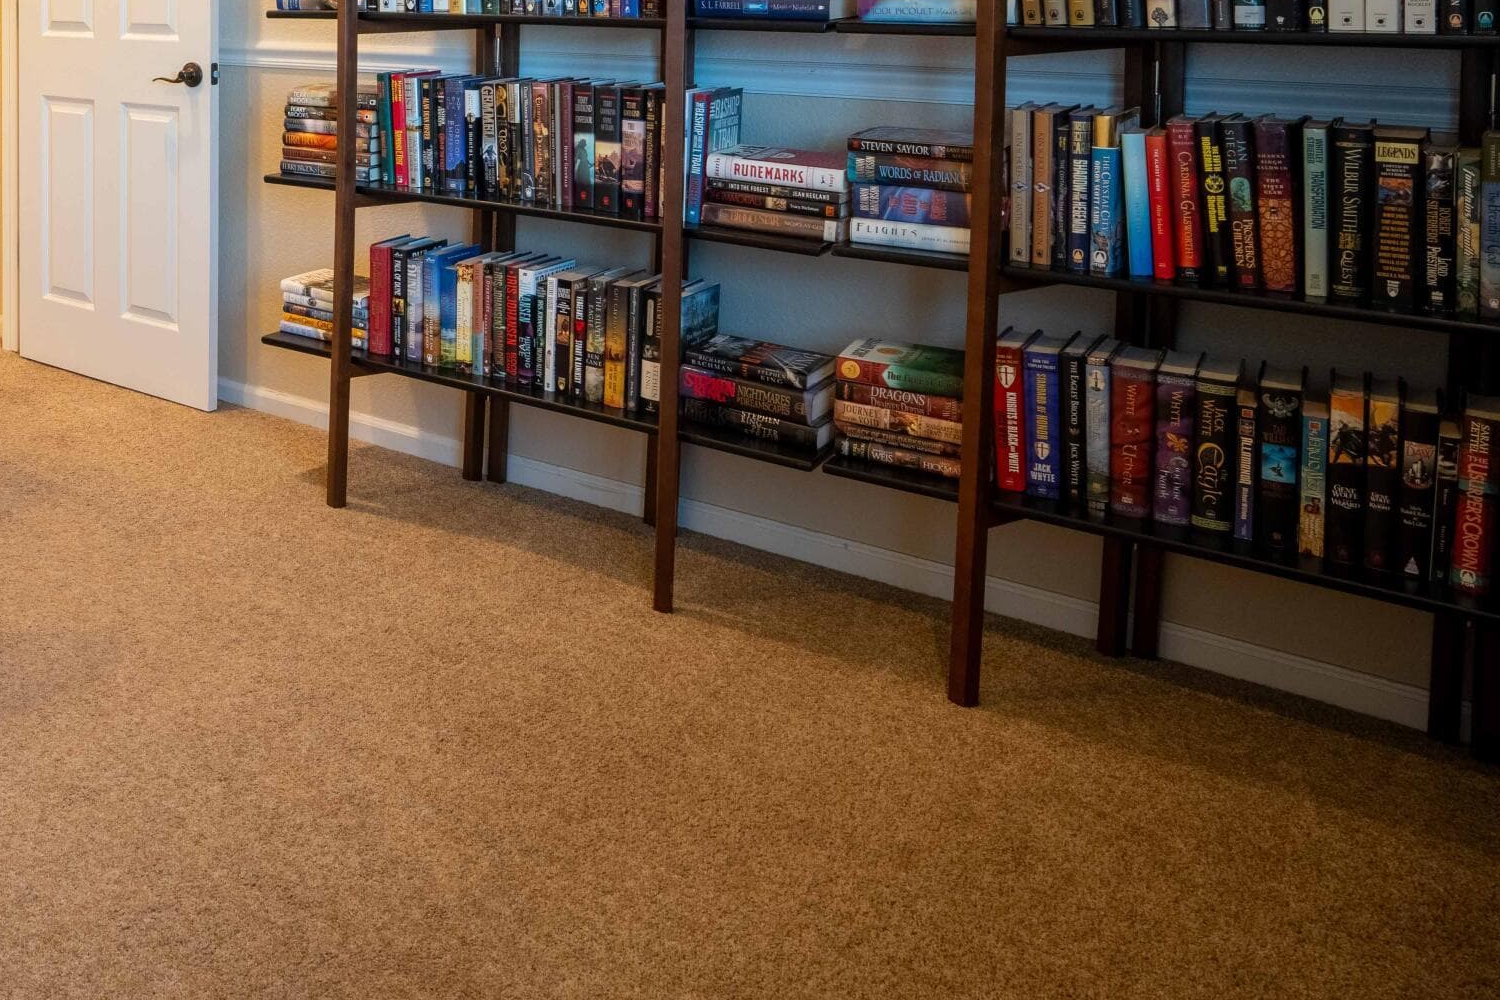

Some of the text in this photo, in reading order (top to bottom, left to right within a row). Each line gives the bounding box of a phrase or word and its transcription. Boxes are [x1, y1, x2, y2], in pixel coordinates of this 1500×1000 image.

[861, 140, 930, 156] STEVEN SAYLOR
[1202, 136, 1212, 172] HORSEMAN
[1225, 130, 1237, 172] SIEGEL
[1314, 138, 1323, 163] WHITLEY
[1377, 146, 1417, 158] LEGENDS
[733, 163, 804, 184] RUNEMARKS
[879, 165, 912, 180] WORDS
[1178, 152, 1191, 198] CARDINAL
[1072, 159, 1088, 234] SHADOW HEGEMON
[1100, 171, 1111, 208] CRYSTAL
[1312, 170, 1325, 231] TRANSFORMATION
[1217, 195, 1227, 221] Richard
[1341, 149, 1363, 286] WILBUR SMITH QUEST
[856, 222, 918, 238] FLIGHTS
[1101, 210, 1112, 234] CITY
[1427, 200, 1439, 243] SILVERBERG
[1232, 220, 1245, 267] CHILDREN
[506, 275, 517, 346] IRIS JOHANSEN
[737, 385, 791, 406] NIGHTMARES
[870, 386, 925, 406] DRAGONS
[843, 403, 879, 418] JOURNEY
[1070, 401, 1080, 425] BROOD
[1214, 409, 1226, 432] JACK
[1006, 391, 1020, 473] KNIGHTS BLACK WHITE
[1469, 421, 1480, 454] ZETTEL
[1479, 424, 1491, 454] SARAH
[871, 450, 894, 463] WEIS
[1070, 443, 1080, 459] JACK
[1070, 460, 1080, 485] WHYTE
[1465, 464, 1489, 523] USURPER'S
[1461, 523, 1484, 569] CROWN
